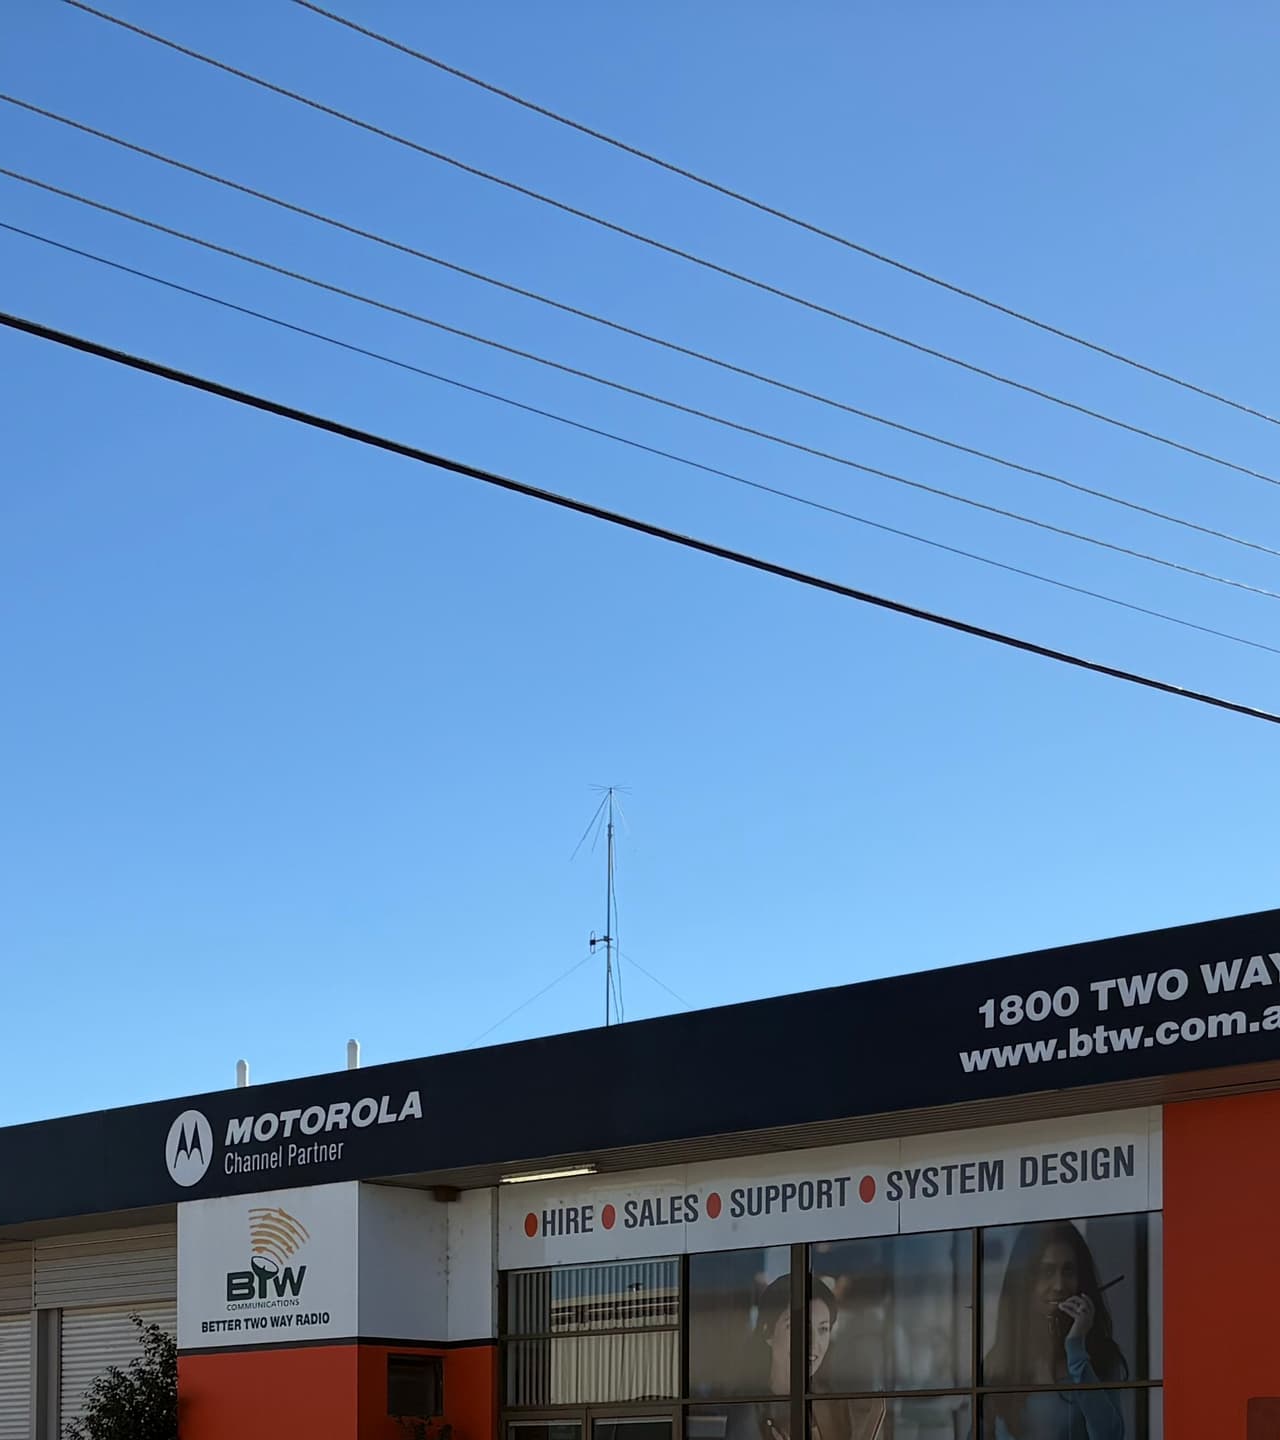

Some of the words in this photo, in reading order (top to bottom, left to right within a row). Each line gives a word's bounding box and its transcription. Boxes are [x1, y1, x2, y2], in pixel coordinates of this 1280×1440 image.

[978, 986, 1080, 1029] 1800
[1090, 968, 1189, 1011] TWO
[224, 1090, 423, 1146] MOTOROLA
[224, 1145, 283, 1175] Channel
[288, 1142, 345, 1167] Partner
[540, 1204, 595, 1239] HIRE
[623, 1194, 699, 1230] SALES
[730, 1175, 852, 1219] SUPPORT
[886, 1159, 1005, 1202] SYSTEM
[1020, 1144, 1135, 1189] DESIGN
[227, 1256, 307, 1302] BTW
[201, 1319, 242, 1333] BETTER
[244, 1316, 268, 1330] TWO
[270, 1314, 294, 1328] WAY
[295, 1311, 330, 1327] RADIO
[226, 1298, 300, 1312] COMMUNICATIONS
